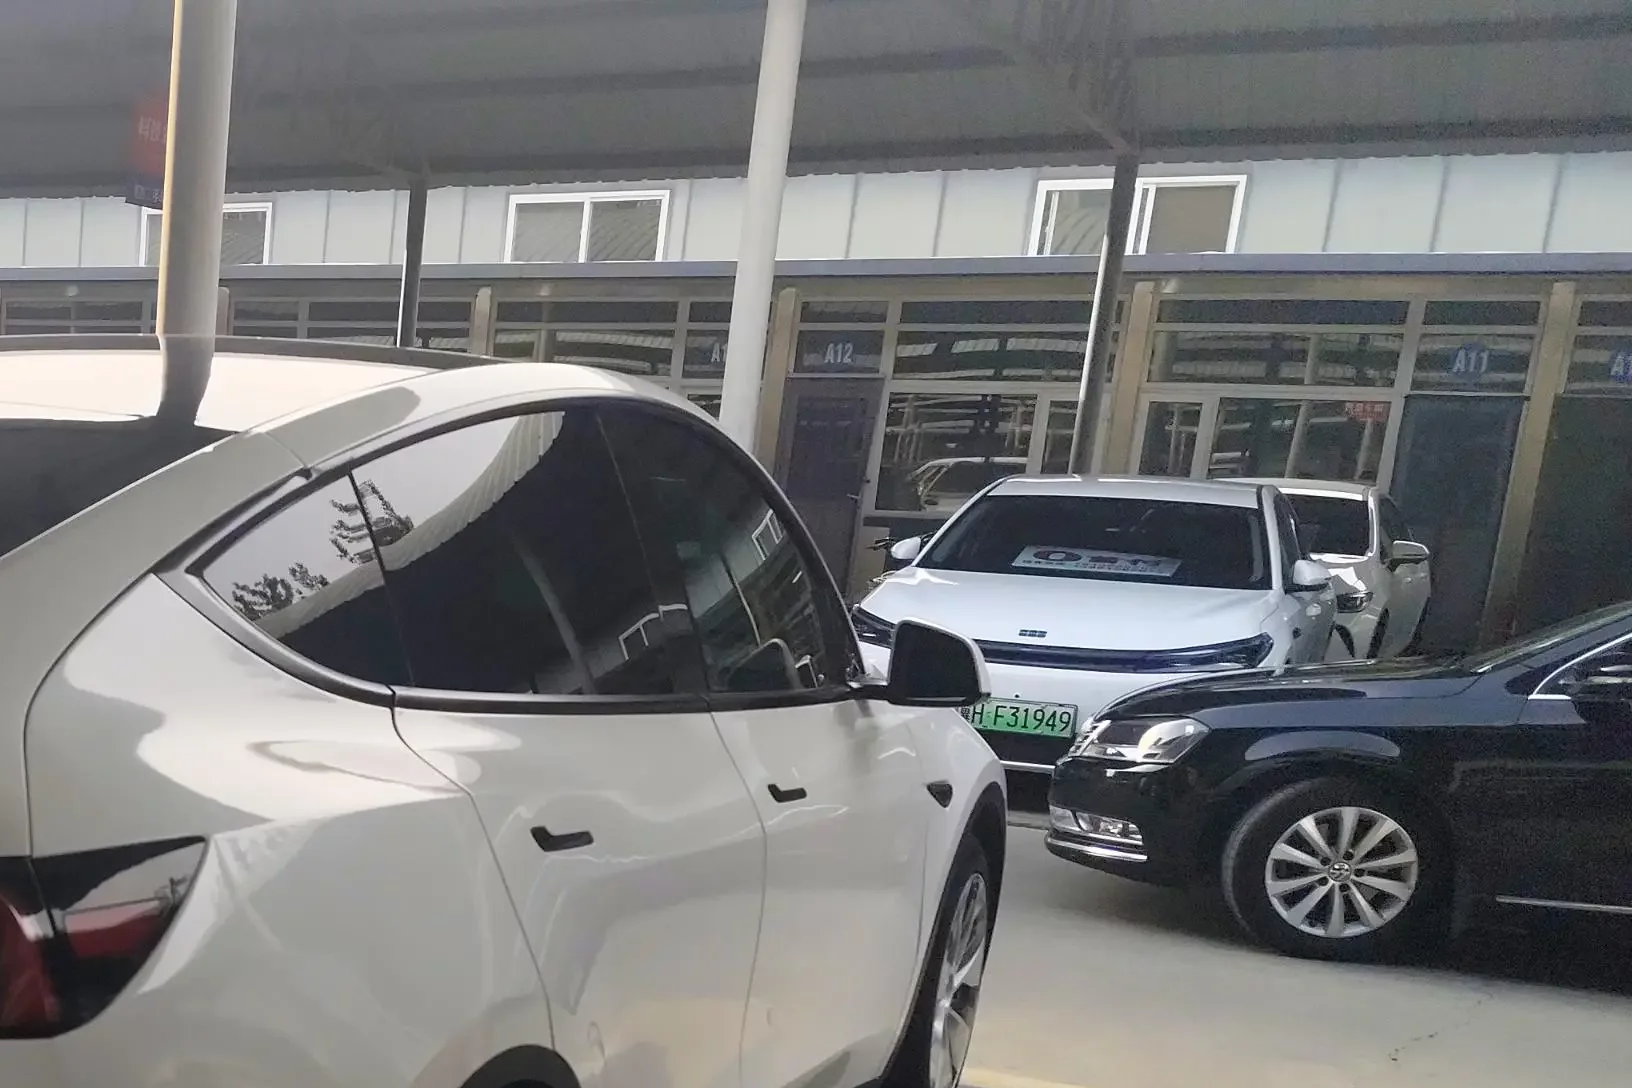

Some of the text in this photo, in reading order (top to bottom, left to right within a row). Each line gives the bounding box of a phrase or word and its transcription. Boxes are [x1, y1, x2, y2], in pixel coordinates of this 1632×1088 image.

[710, 342, 728, 363] A1
[824, 343, 854, 363] A12
[1452, 348, 1489, 373] A11
